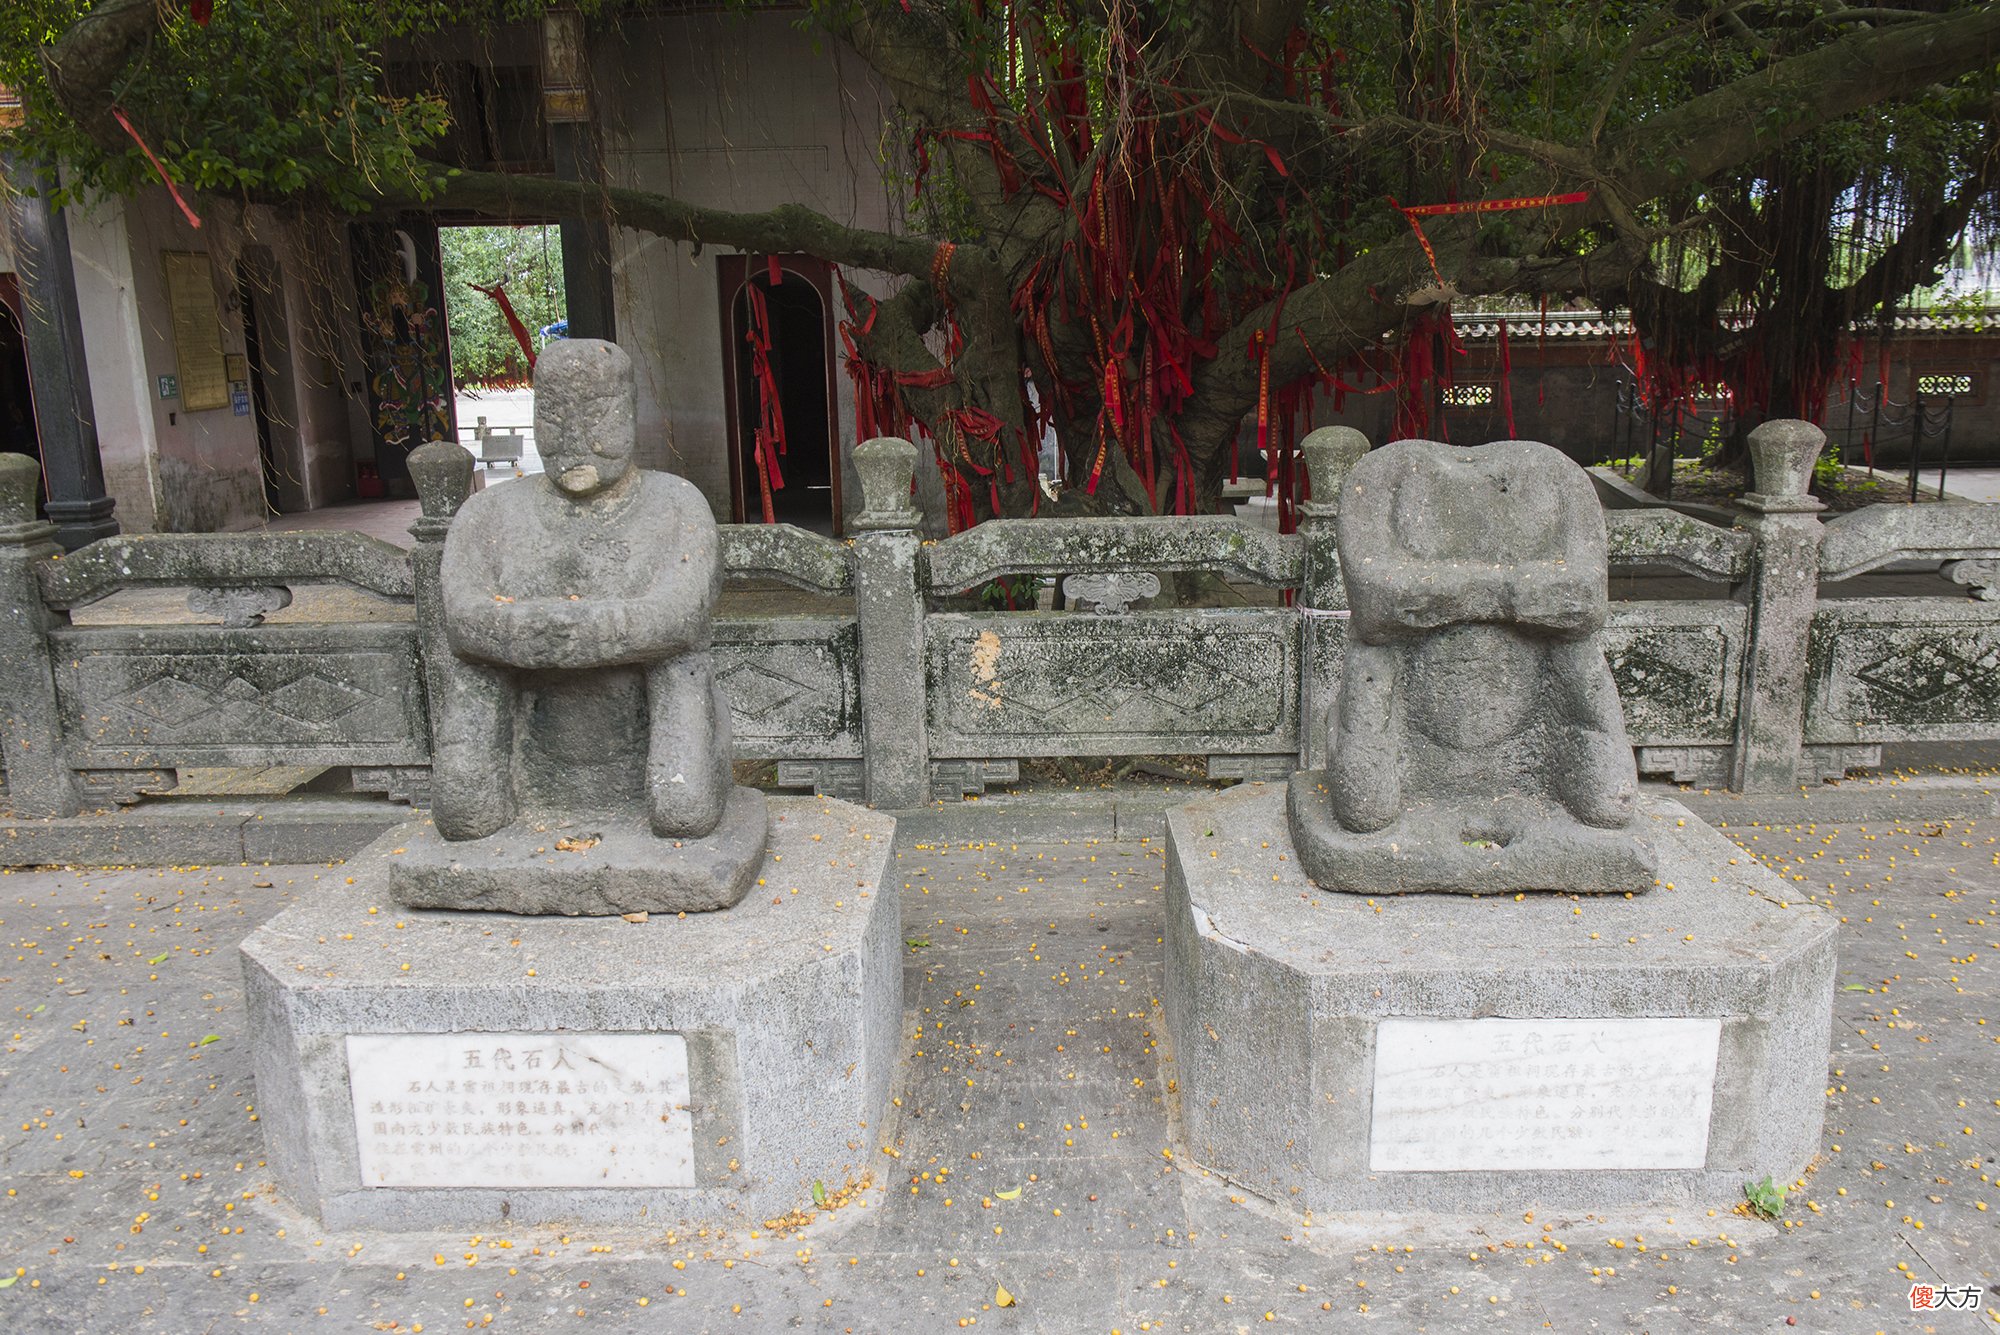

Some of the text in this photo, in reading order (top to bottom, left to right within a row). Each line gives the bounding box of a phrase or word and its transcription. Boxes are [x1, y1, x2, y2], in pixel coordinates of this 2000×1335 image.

[1490, 1031, 1606, 1055] 五代石人
[463, 1047, 576, 1071] 五代石人
